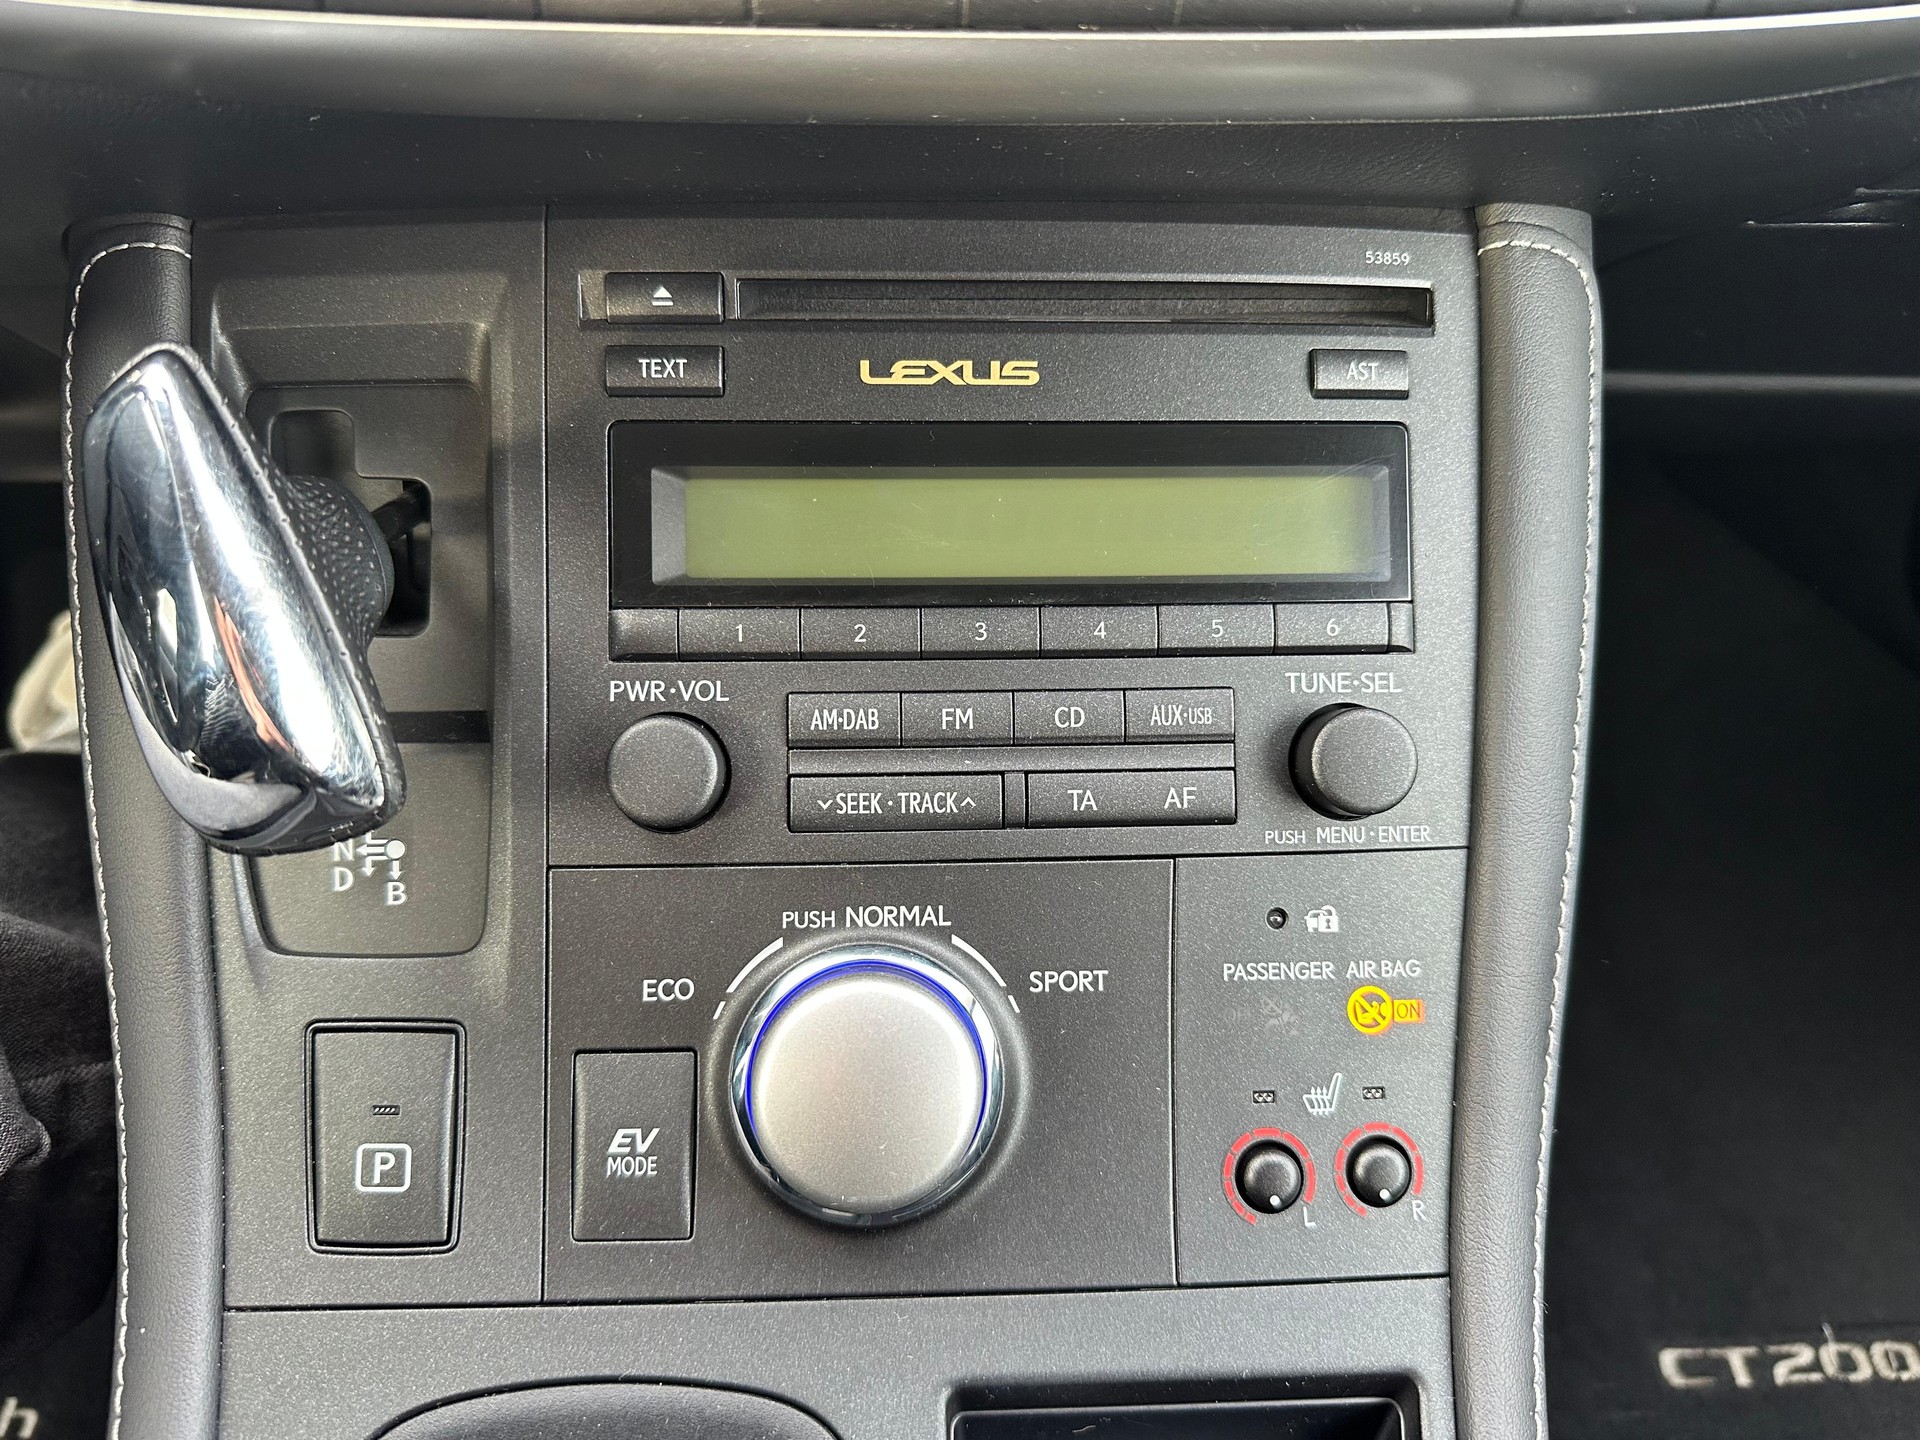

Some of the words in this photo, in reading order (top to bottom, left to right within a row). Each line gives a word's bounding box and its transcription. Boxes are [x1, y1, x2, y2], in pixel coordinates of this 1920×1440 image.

[1365, 251, 1410, 266] 53859
[638, 358, 688, 378] TEXT
[859, 359, 1040, 386] LEXUS
[1346, 361, 1379, 380] AST
[735, 624, 744, 642] 1
[854, 624, 867, 642] 2
[974, 622, 988, 641] 3
[1093, 622, 1107, 639] 4
[1211, 619, 1224, 638] 5
[1326, 618, 1339, 637] 6
[941, 708, 974, 730] FM
[1054, 706, 1085, 728] CD
[1067, 789, 1098, 811] TA
[1163, 787, 1198, 809] AF
[1264, 829, 1306, 845] PUSH
[333, 838, 355, 861] N
[333, 866, 354, 892] D
[386, 881, 407, 906] B
[782, 911, 836, 929] PUSH
[845, 905, 951, 927] NORMAL
[1029, 970, 1109, 993] SPORT
[1223, 962, 1336, 982] PASSENGER
[1345, 960, 1379, 979] AIR
[1381, 959, 1421, 977] BAG
[642, 978, 695, 1001] ECO
[1396, 1002, 1421, 1019] ON
[607, 1128, 660, 1154] EV
[373, 1151, 396, 1184] P
[606, 1155, 658, 1177] MODE
[1303, 1207, 1316, 1227] L
[1412, 1199, 1426, 1221] R
